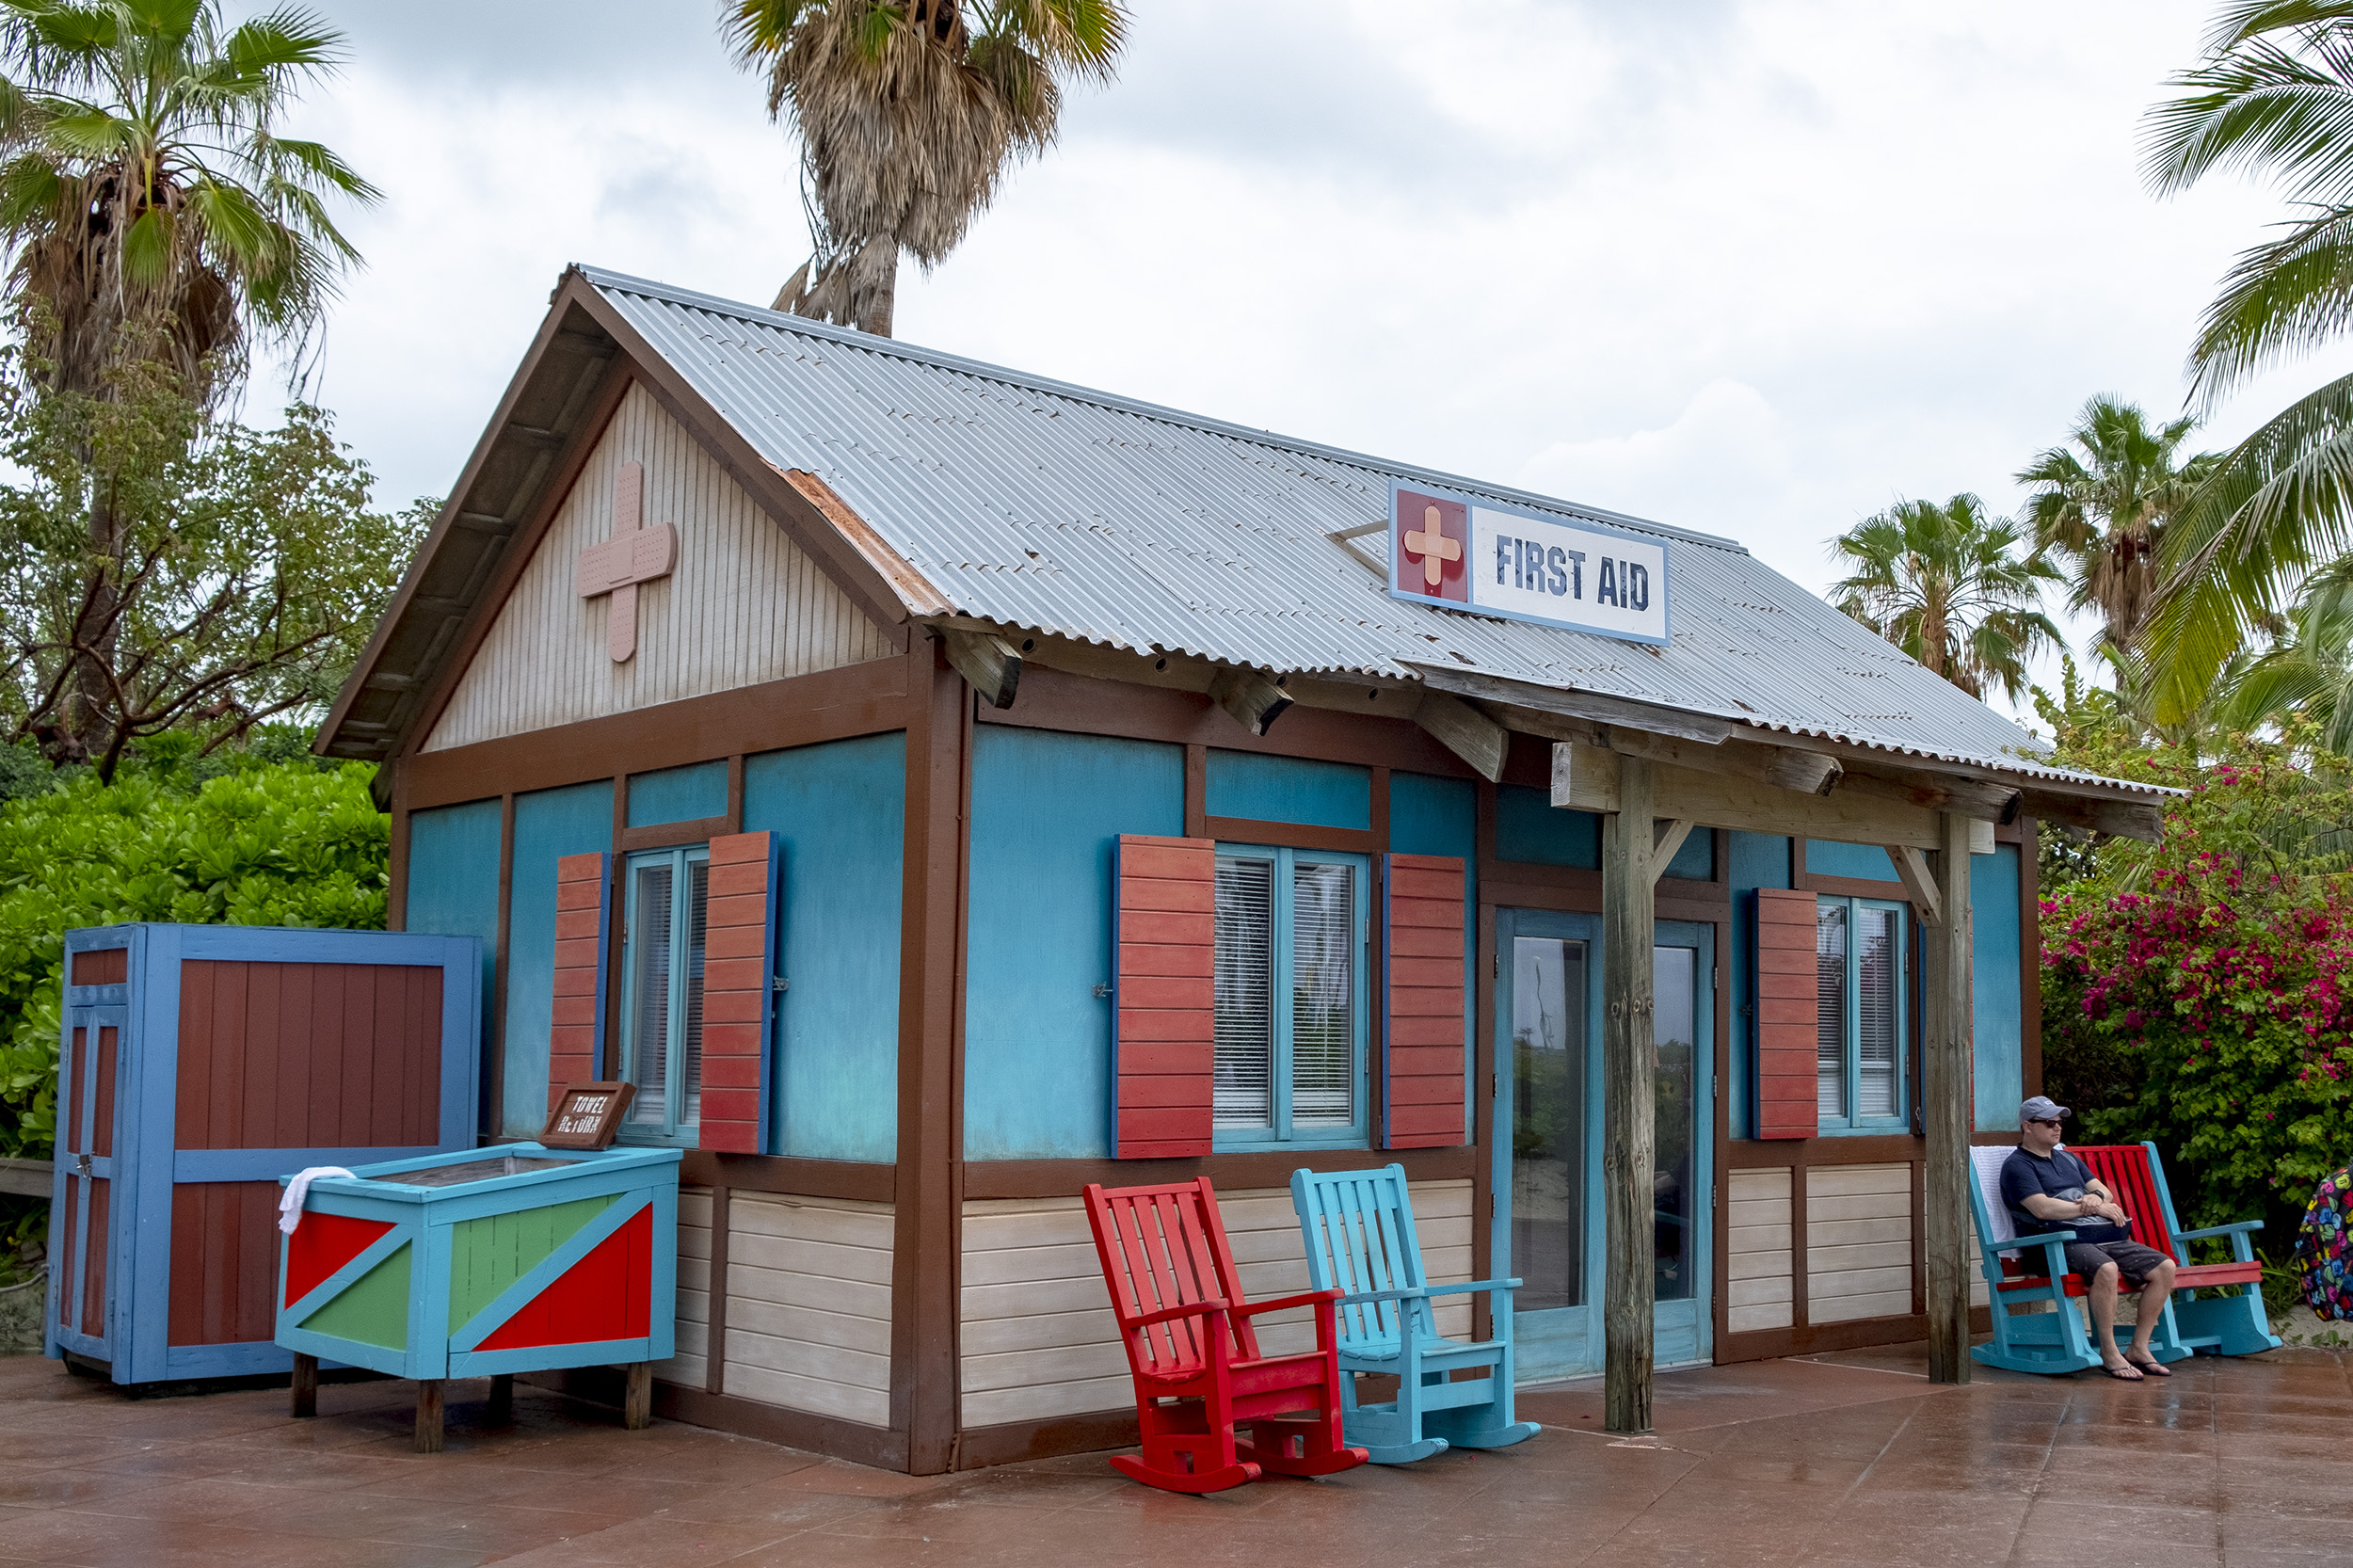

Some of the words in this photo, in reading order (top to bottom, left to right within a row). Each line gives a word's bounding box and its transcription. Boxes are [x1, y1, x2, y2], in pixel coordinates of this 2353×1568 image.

[1497, 535, 1585, 600] FIRST
[1597, 556, 1649, 612] AID
[571, 1096, 608, 1113] TOWEL
